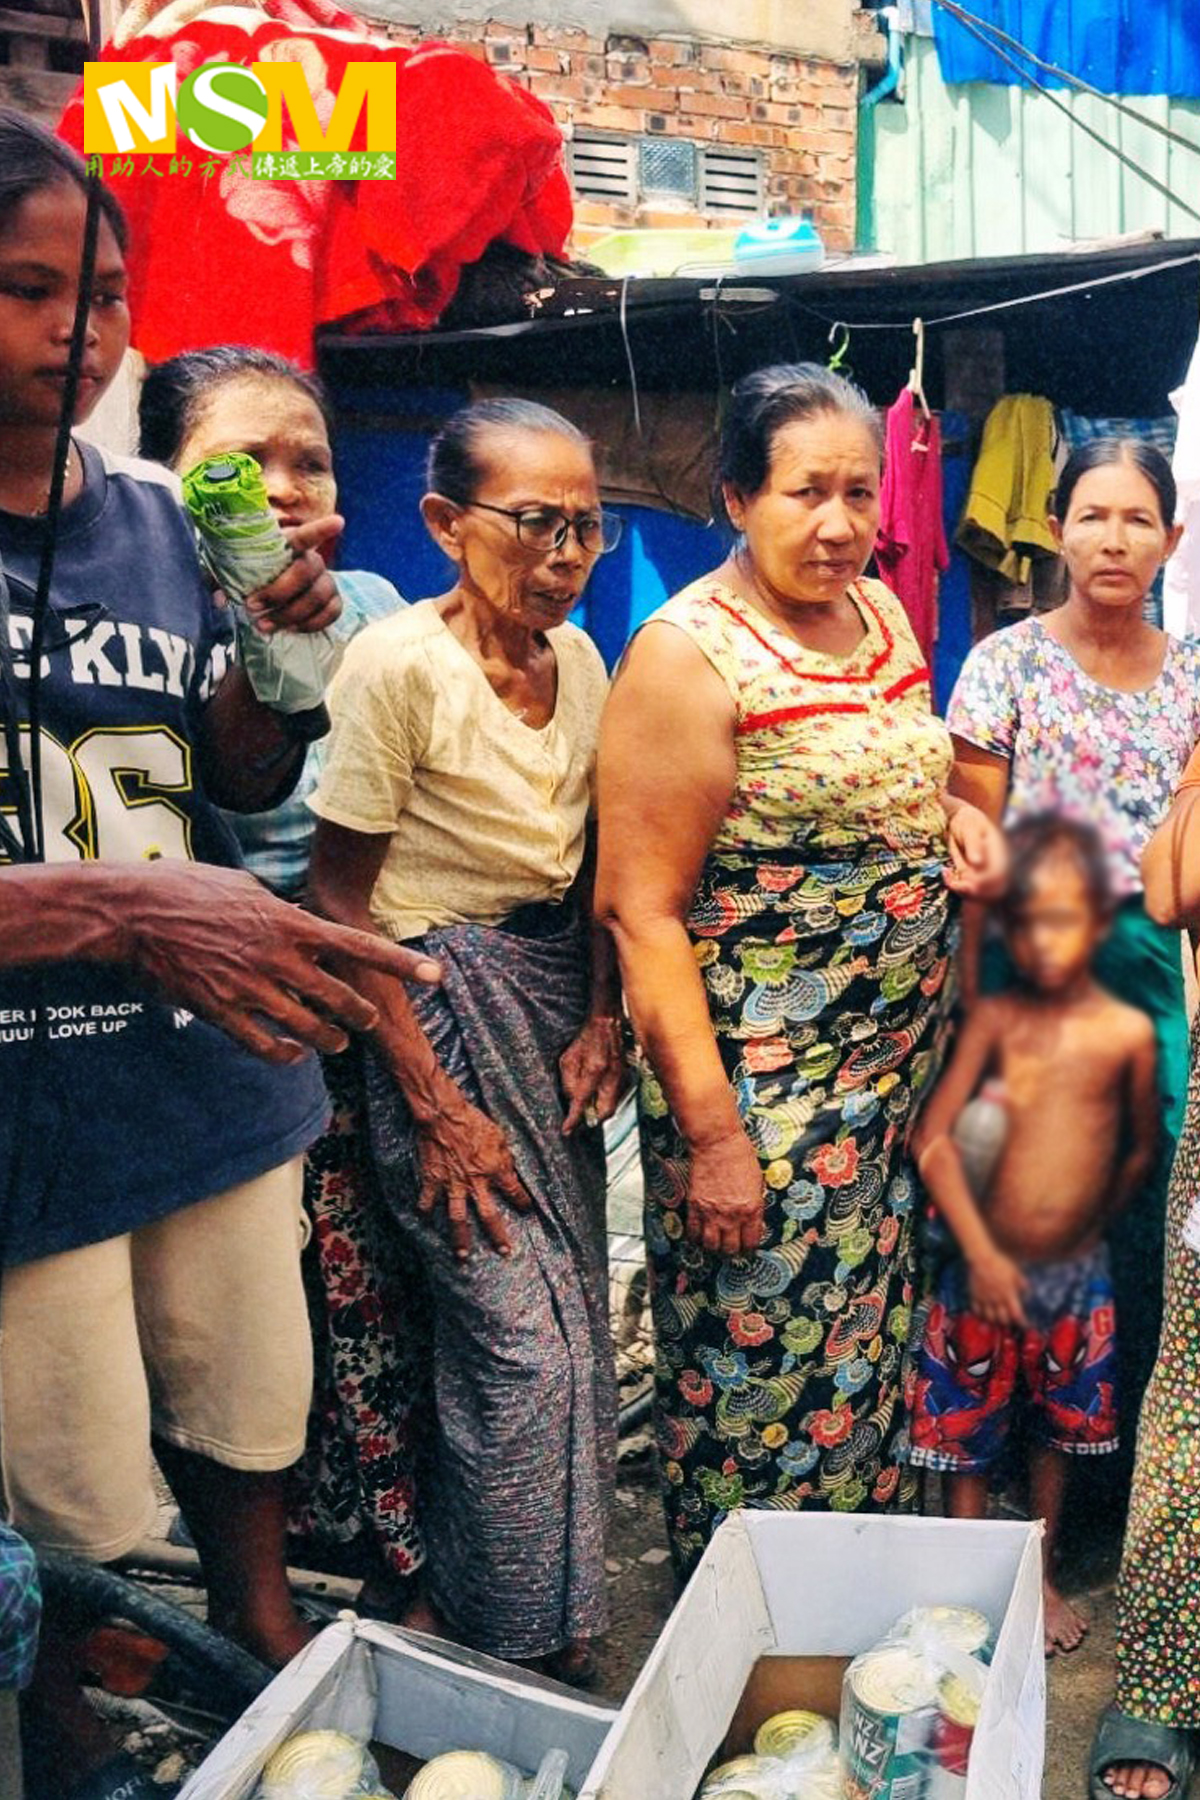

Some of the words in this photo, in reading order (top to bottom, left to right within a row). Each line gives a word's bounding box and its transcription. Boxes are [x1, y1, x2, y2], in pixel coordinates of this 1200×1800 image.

[91, 1002, 144, 1018] BACK
[49, 1022, 98, 1040] LOVE
[101, 1020, 128, 1034] UP
